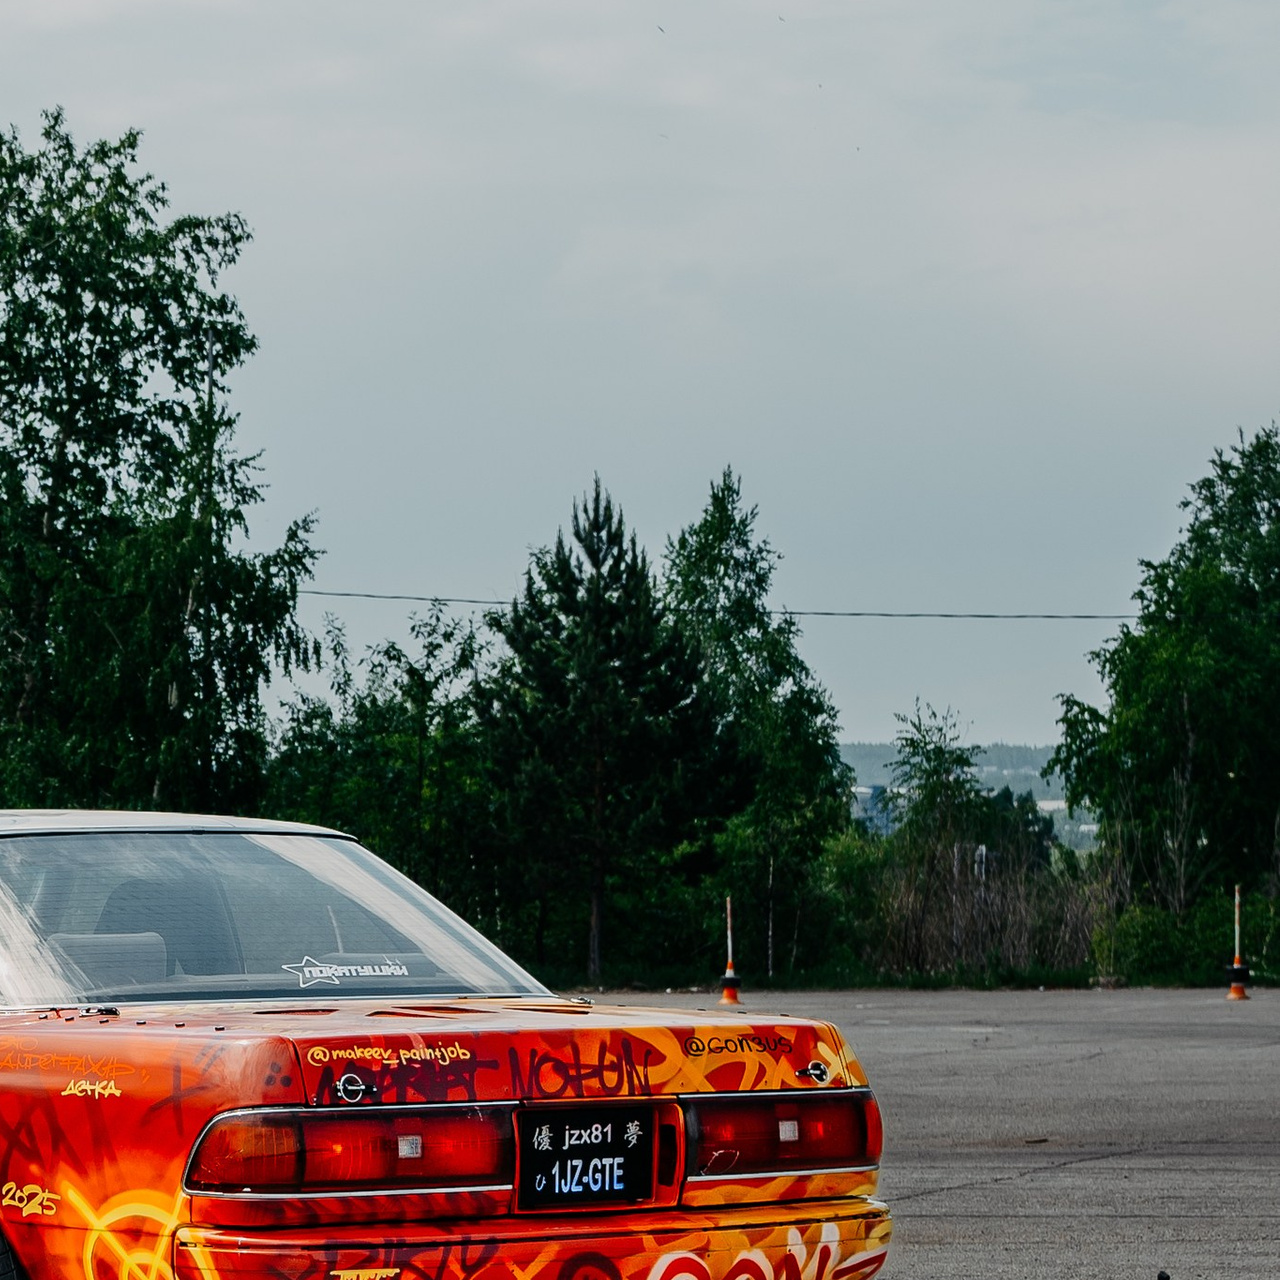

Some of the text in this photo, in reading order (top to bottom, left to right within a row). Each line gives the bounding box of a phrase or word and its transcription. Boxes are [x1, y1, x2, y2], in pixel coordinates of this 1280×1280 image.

[307, 1041, 471, 1067] @makeev_paintjob
[562, 1123, 612, 1150] jzx81
[2, 1181, 61, 1217] 2025
